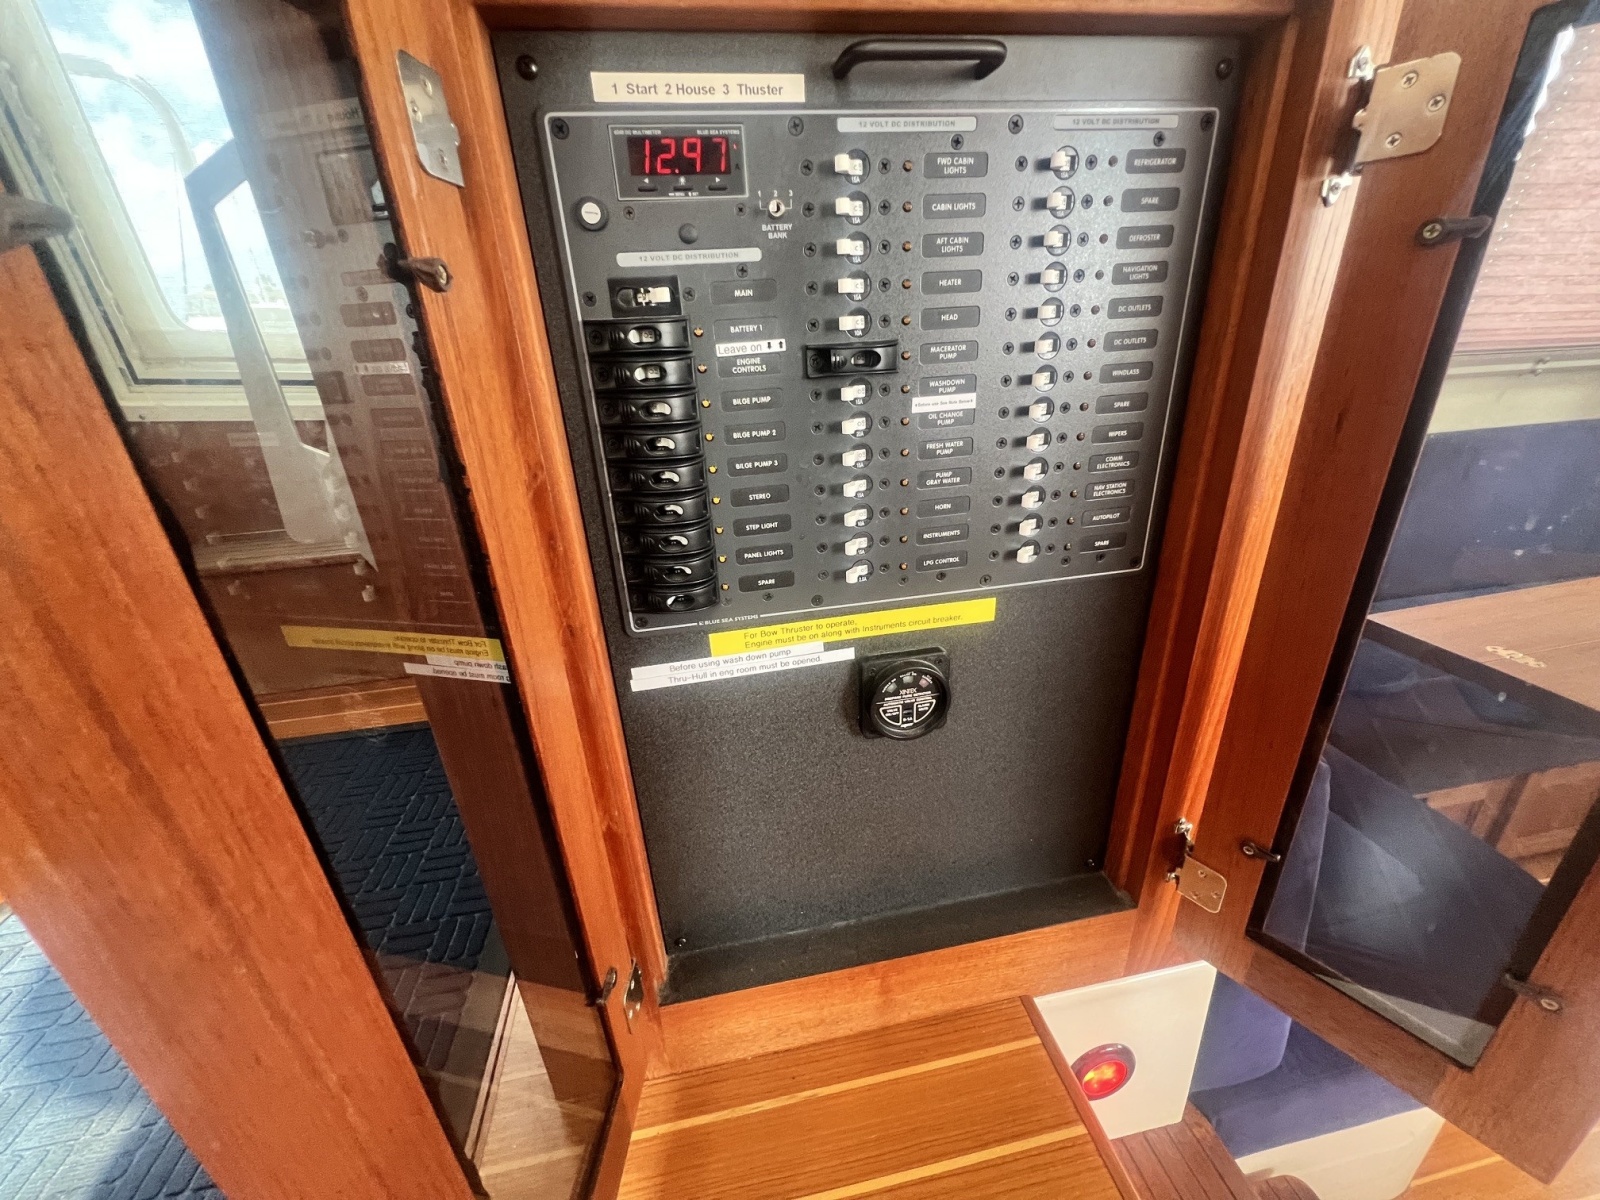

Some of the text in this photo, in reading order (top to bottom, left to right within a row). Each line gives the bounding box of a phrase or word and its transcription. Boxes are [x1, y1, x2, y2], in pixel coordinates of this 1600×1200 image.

[611, 83, 783, 96] 1 Start 2 House 3 Thuster
[645, 138, 727, 174] 12.97
[954, 157, 974, 165] CABIN
[1134, 158, 1177, 166] REFRIGERATOR
[1141, 197, 1159, 205] SPARE
[932, 203, 952, 211] CABIN
[762, 223, 793, 232] BATTERY
[950, 237, 969, 245] CABIN
[1129, 234, 1161, 242] DEFROSTER
[685, 252, 739, 261] DISTRIBUTION
[1123, 265, 1158, 273] NAVIGATION
[939, 279, 961, 287] HEATER
[734, 289, 753, 297] MAIN
[1128, 304, 1151, 312] OUTLETS
[730, 325, 757, 333] BATTERY
[1124, 337, 1147, 345] OUTLETS
[718, 343, 762, 355] Leave on
[732, 365, 766, 373] CONTROLS
[929, 379, 965, 387] WASHDOWN
[733, 396, 771, 405] BILGE PUMP
[939, 410, 963, 418] CHANGE
[733, 431, 750, 439] BILGE
[945, 440, 964, 448] WATER
[754, 460, 772, 468] PUMP
[1096, 461, 1130, 469] ELECTRONICS
[926, 478, 941, 486] GRAY
[1093, 488, 1126, 497] ELECTRONICS
[1092, 513, 1120, 521] AUTOPILOT
[746, 521, 778, 531] STEP LIGHT
[923, 530, 960, 539] INSTRUMENTS
[744, 549, 784, 559] PANEL LIGHTS
[924, 557, 959, 567] LPG CONTROL
[758, 578, 775, 586] SPARE
[744, 619, 857, 640] For Bow Thruster to operate.
[745, 638, 772, 650] Engine
[775, 635, 795, 644] must
[797, 634, 807, 642] be
[821, 630, 842, 640] along
[845, 626, 860, 635] with
[862, 621, 907, 633] Instruments
[908, 617, 931, 627] circuit
[933, 614, 963, 624] breaker.
[669, 649, 791, 673] Before using wash down pump
[668, 656, 822, 684] Thru-Hull in eng room must be opened.
